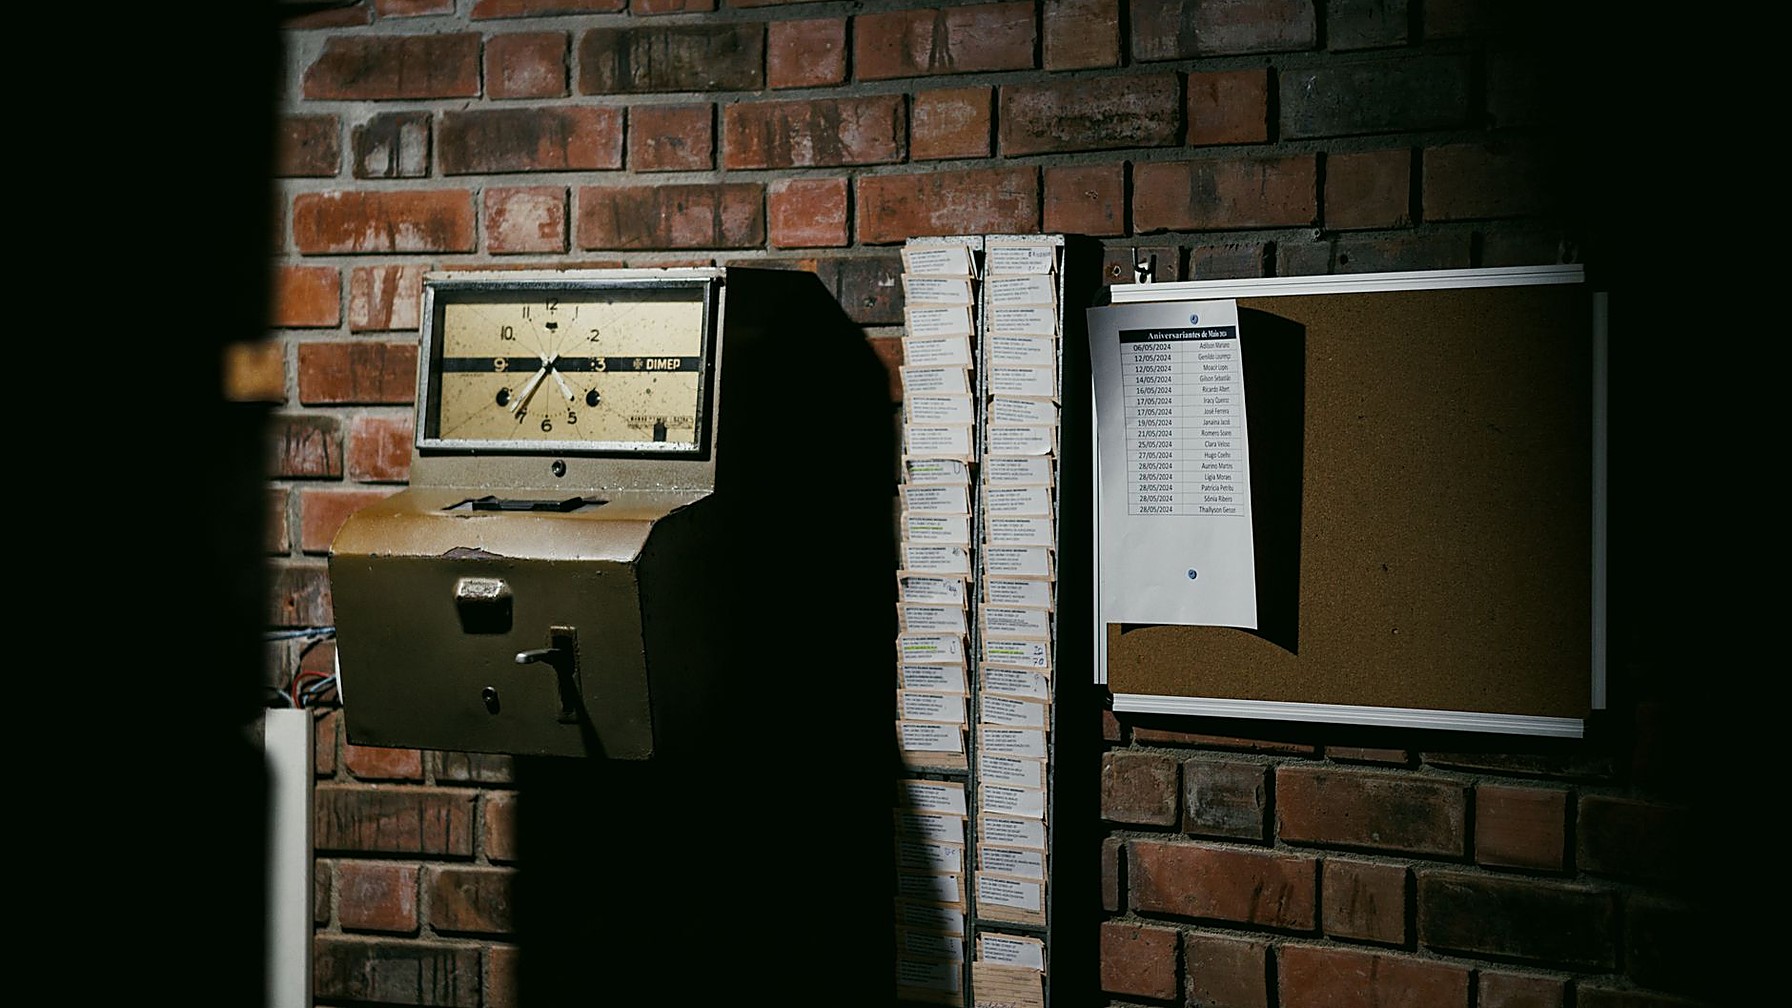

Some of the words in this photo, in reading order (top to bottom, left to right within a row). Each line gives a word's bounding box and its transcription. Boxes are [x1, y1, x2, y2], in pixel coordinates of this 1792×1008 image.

[546, 298, 559, 311] 12
[522, 306, 530, 319] 11
[590, 329, 600, 342] 2
[1148, 330, 1201, 340] Aniversariantes
[1201, 330, 1208, 338] de
[1133, 344, 1172, 352] 06/05/2024
[1134, 354, 1172, 362] 12/05/2024
[494, 357, 506, 373] 9
[594, 357, 607, 372] 3
[645, 358, 681, 371] DIMEP
[1135, 365, 1172, 373] 12/05/2024
[1136, 376, 1172, 384] 14/05/2024
[1137, 397, 1173, 405] 17/05/2024
[1137, 408, 1173, 416] 17/05/2024
[567, 411, 577, 425] 5
[541, 419, 552, 432] 6
[1138, 419, 1173, 427] 19/05/2024
[1138, 430, 1173, 438] 21/05/2024
[1204, 452, 1217, 460] Hugo
[1139, 462, 1173, 470] 28/05/2024
[1139, 473, 1173, 481] 28/05/2024
[1139, 484, 1173, 492] 28/05/2024
